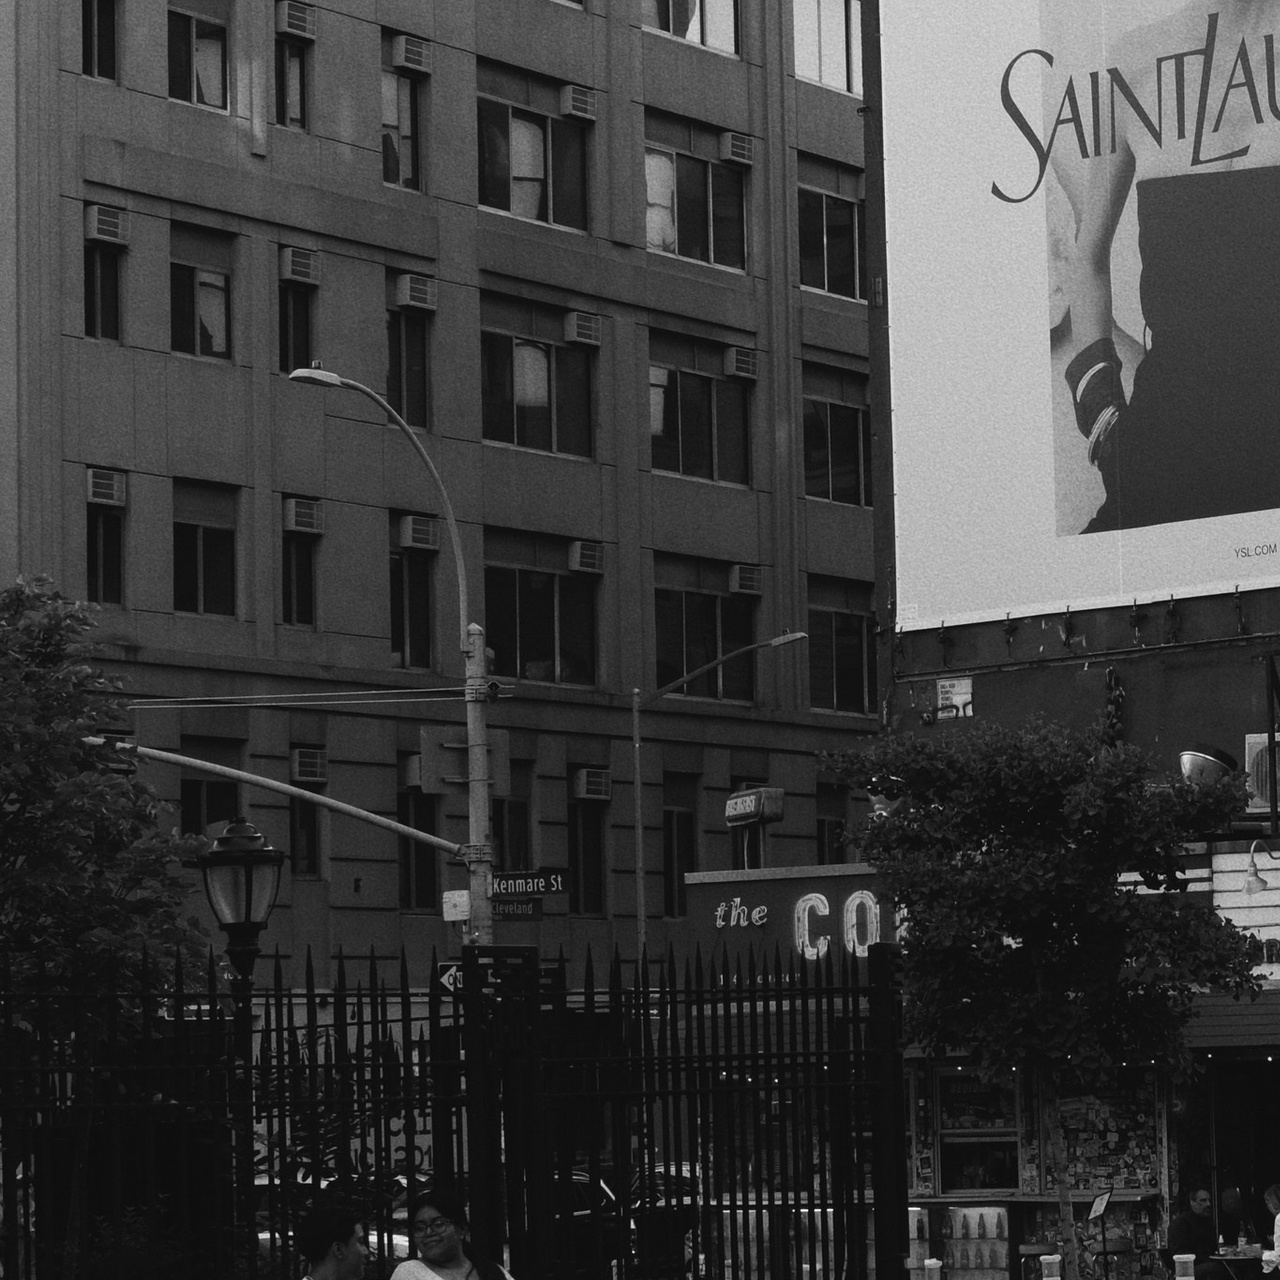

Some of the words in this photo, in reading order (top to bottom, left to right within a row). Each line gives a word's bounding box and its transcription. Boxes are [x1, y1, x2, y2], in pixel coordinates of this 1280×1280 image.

[1233, 543, 1278, 558] YSL.COM
[493, 877, 546, 894] Kenmare
[550, 874, 563, 891] St
[714, 897, 768, 929] the
